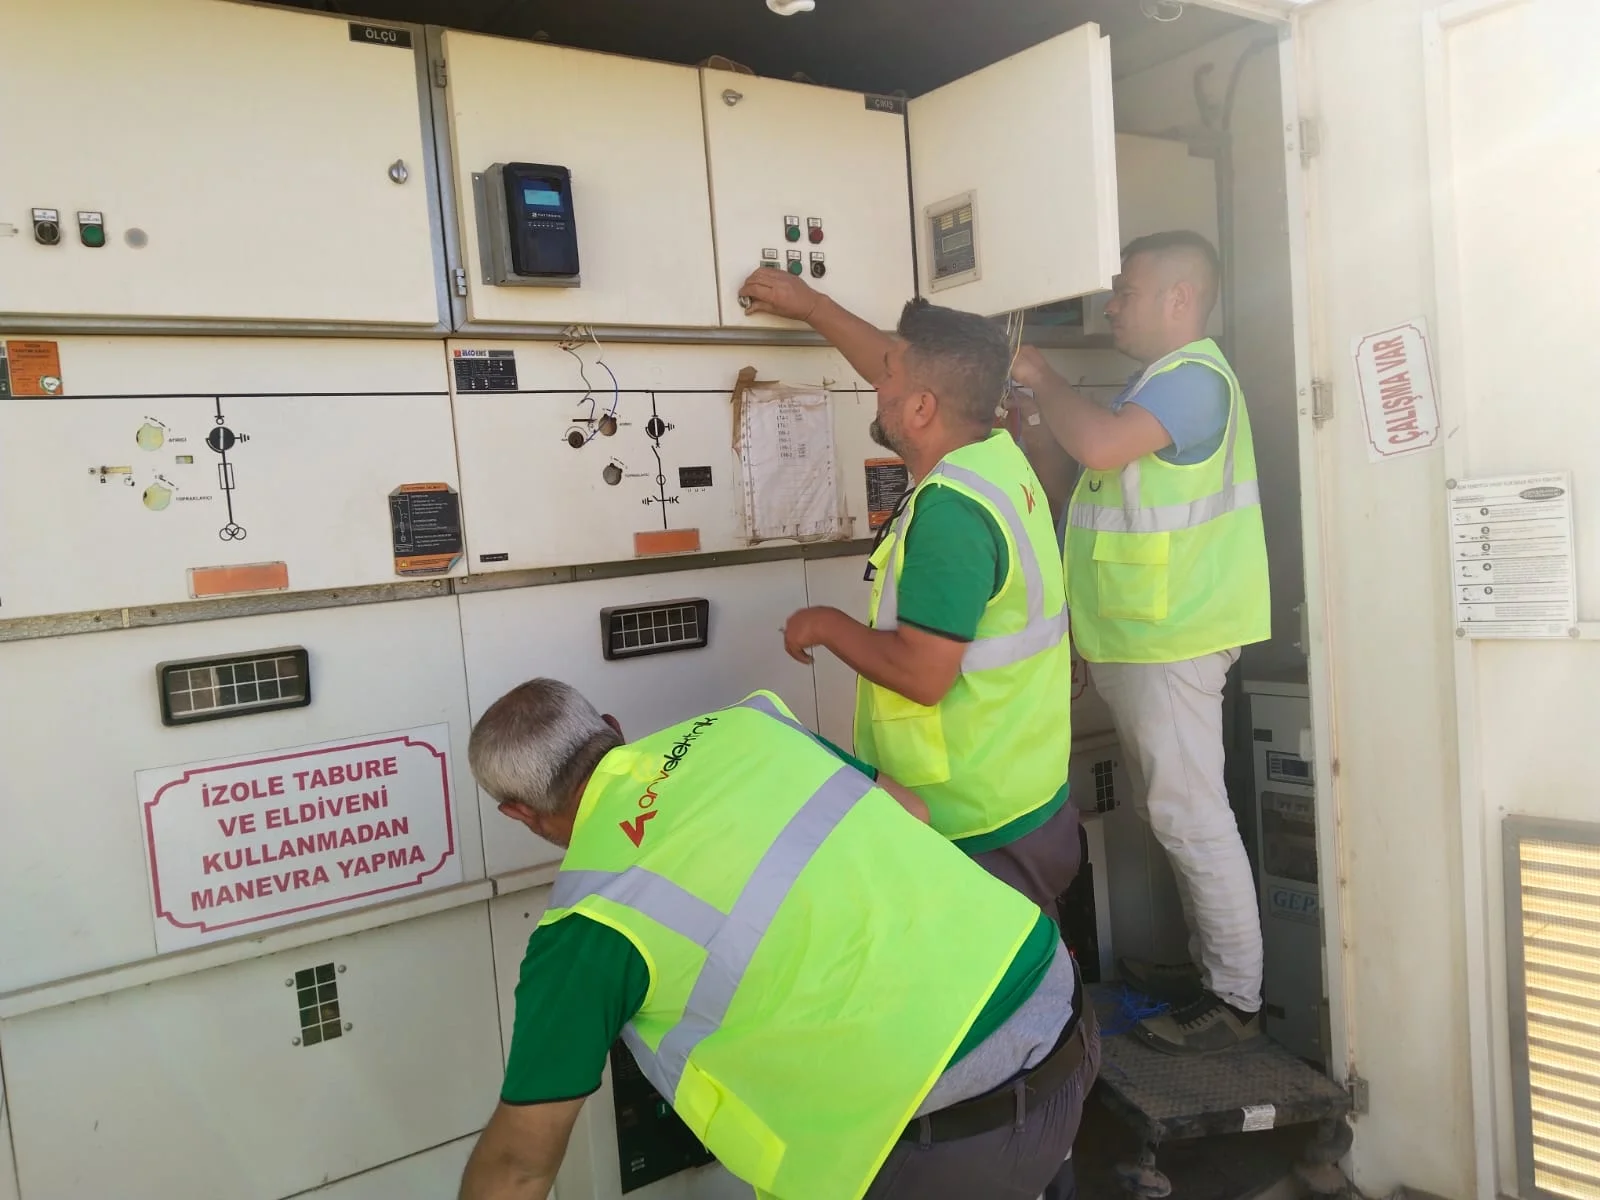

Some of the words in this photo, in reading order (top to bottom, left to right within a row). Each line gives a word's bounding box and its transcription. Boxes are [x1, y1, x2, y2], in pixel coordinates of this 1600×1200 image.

[365, 27, 397, 43] ÖLÇÜ
[1372, 335, 1408, 374] VAR
[1379, 370, 1429, 445] ÇALIŞMA
[202, 775, 285, 808] İZOLE
[292, 756, 398, 792] TABURE
[217, 813, 257, 838] VE
[265, 784, 389, 830] ELDİVENİ
[202, 816, 410, 876] KULLANMADAN
[190, 864, 330, 912] MANEVRA
[336, 844, 426, 882] YAPMA
[1273, 890, 1318, 913] GEP
